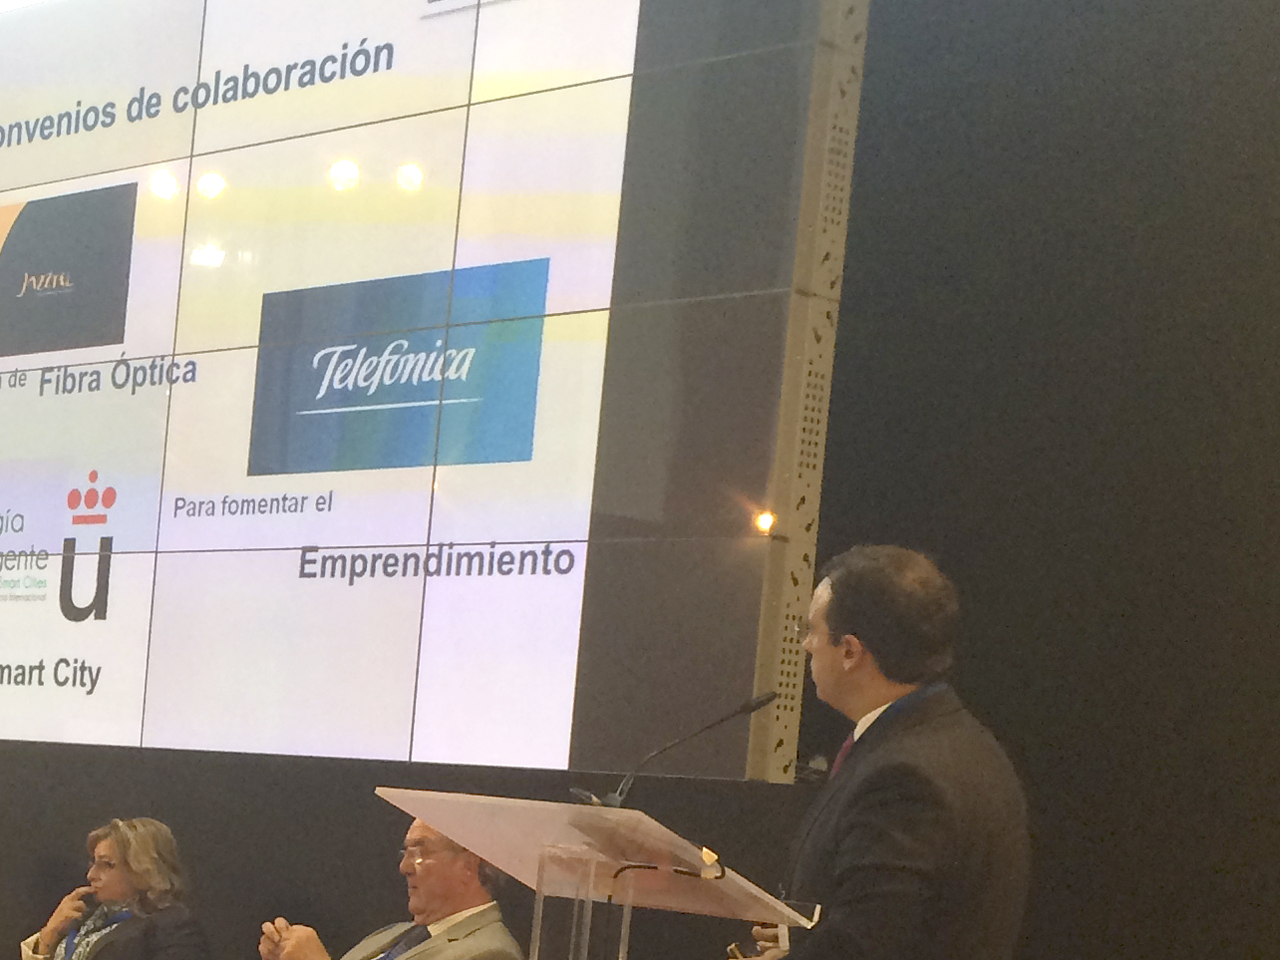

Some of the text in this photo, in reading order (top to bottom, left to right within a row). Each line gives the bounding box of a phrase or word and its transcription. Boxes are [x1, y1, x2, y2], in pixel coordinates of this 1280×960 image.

[127, 87, 161, 122] de
[172, 38, 394, 113] colaboración
[7, 368, 27, 388] de
[39, 366, 101, 397] Fibra
[111, 351, 197, 395] Óptica
[173, 490, 333, 518] Para fomentar el
[299, 541, 575, 586] Emprendimiento
[53, 657, 102, 696] City
